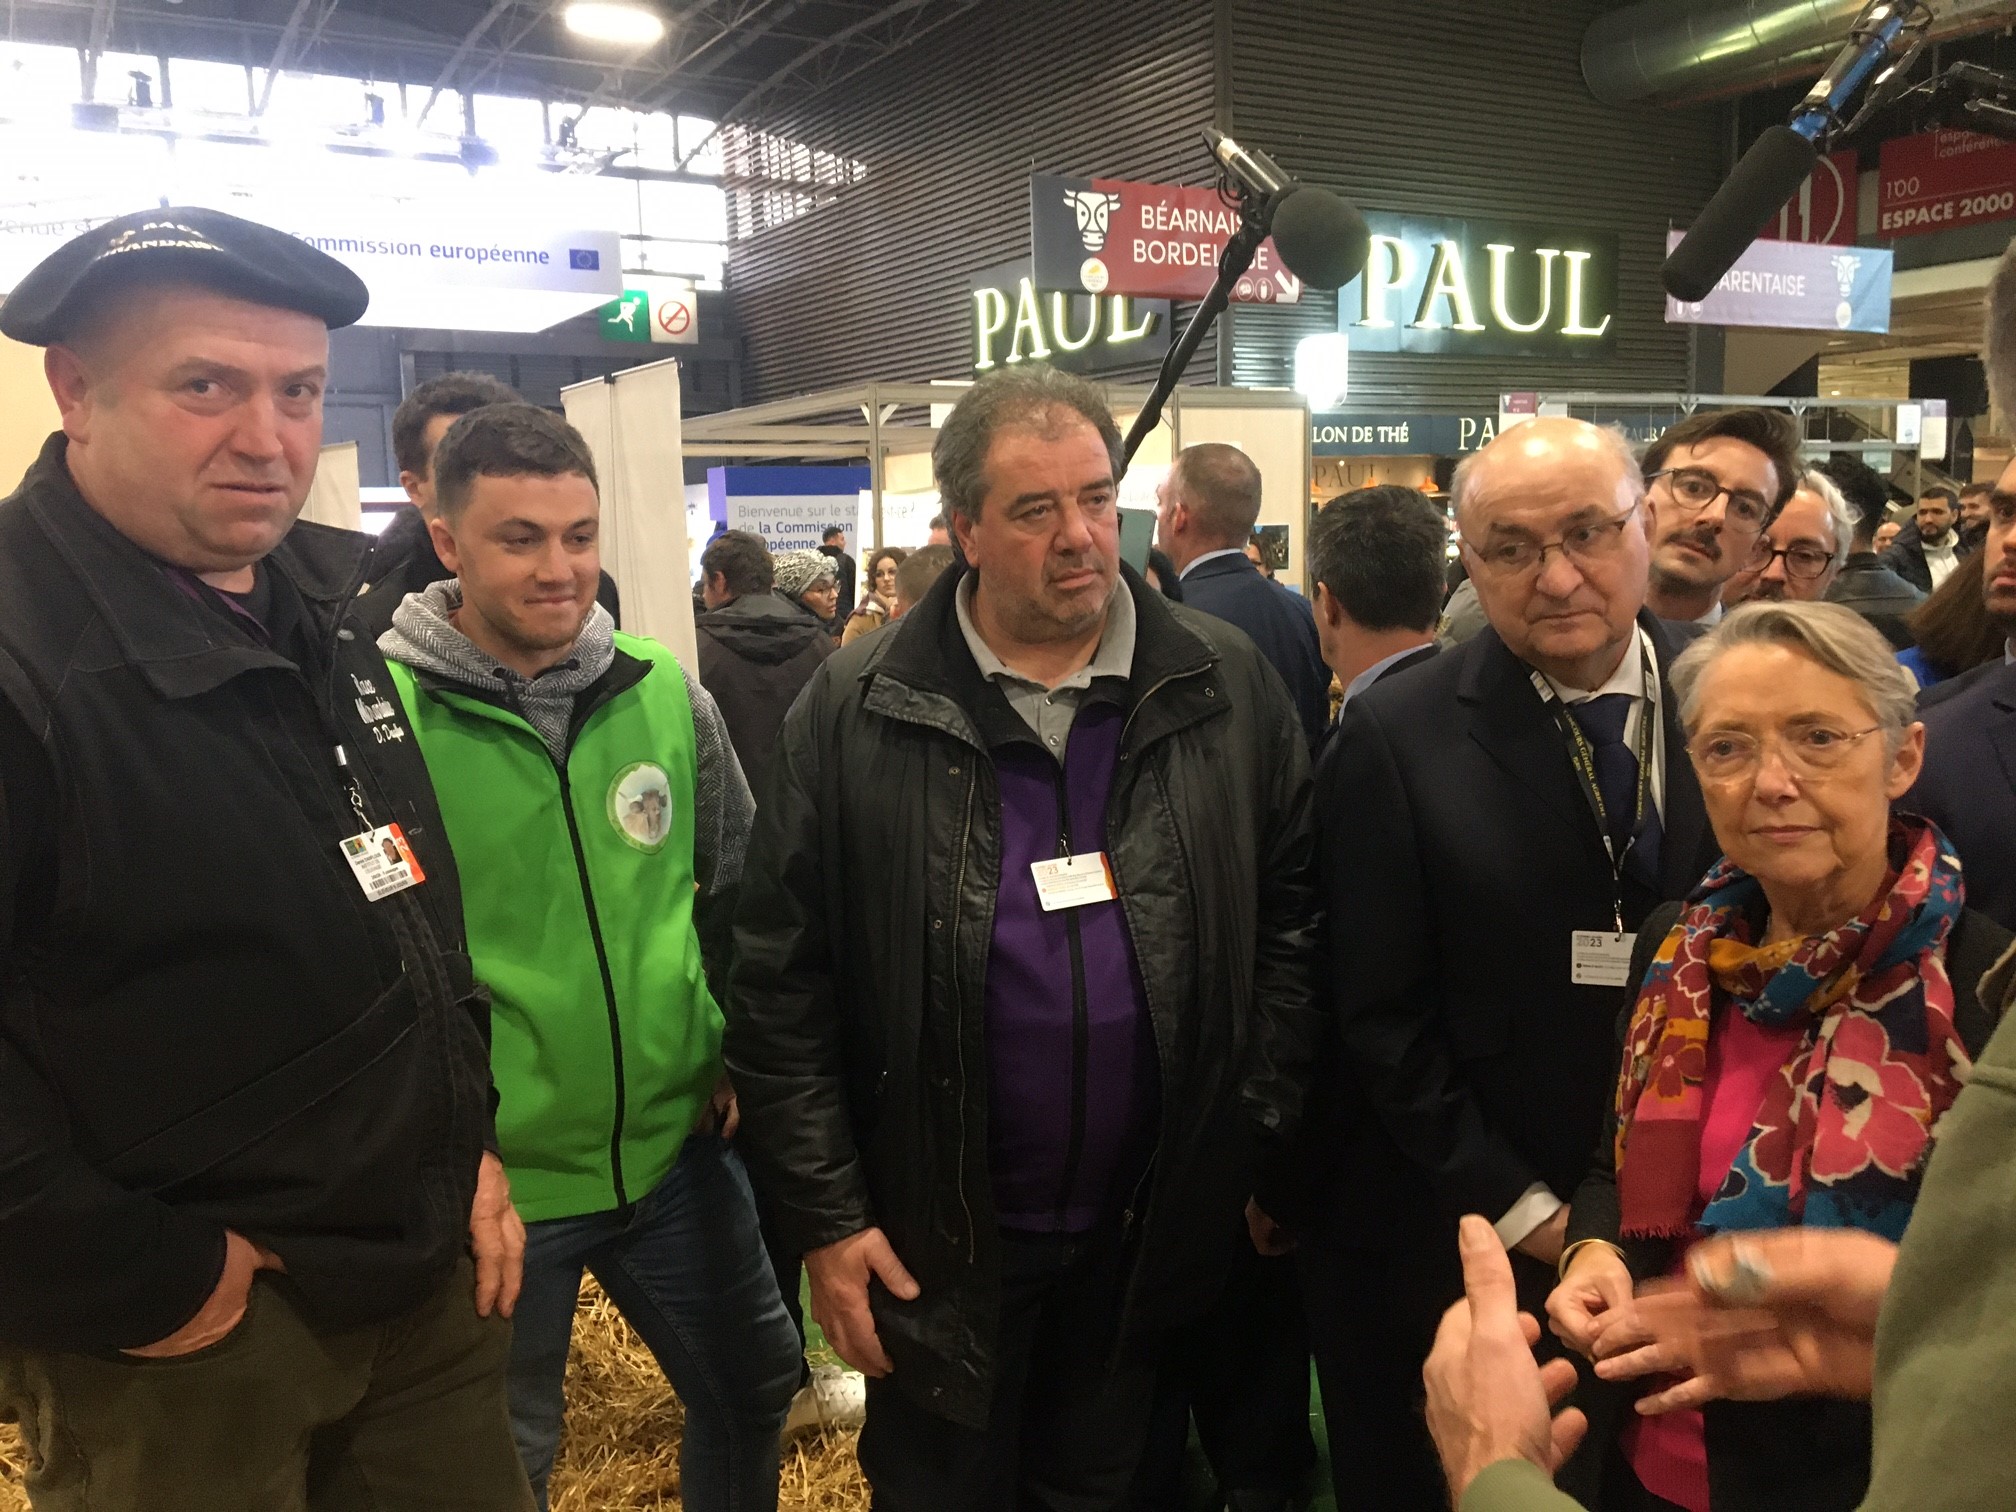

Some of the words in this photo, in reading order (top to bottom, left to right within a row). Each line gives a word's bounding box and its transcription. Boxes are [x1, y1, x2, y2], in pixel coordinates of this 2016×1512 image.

[1882, 202, 1954, 231] ESPACE
[1959, 192, 2015, 218] 2000
[430, 243, 550, 265] européenne
[1352, 234, 1611, 336] PAUL
[1714, 270, 1806, 297] ARENTAISE
[973, 277, 1152, 369] PAUL
[1352, 426, 1374, 443] DE
[1377, 421, 1410, 443] THÉ
[738, 504, 804, 518] Bienvenue
[807, 506, 826, 517] sur
[830, 504, 841, 517] le
[759, 521, 772, 534] la
